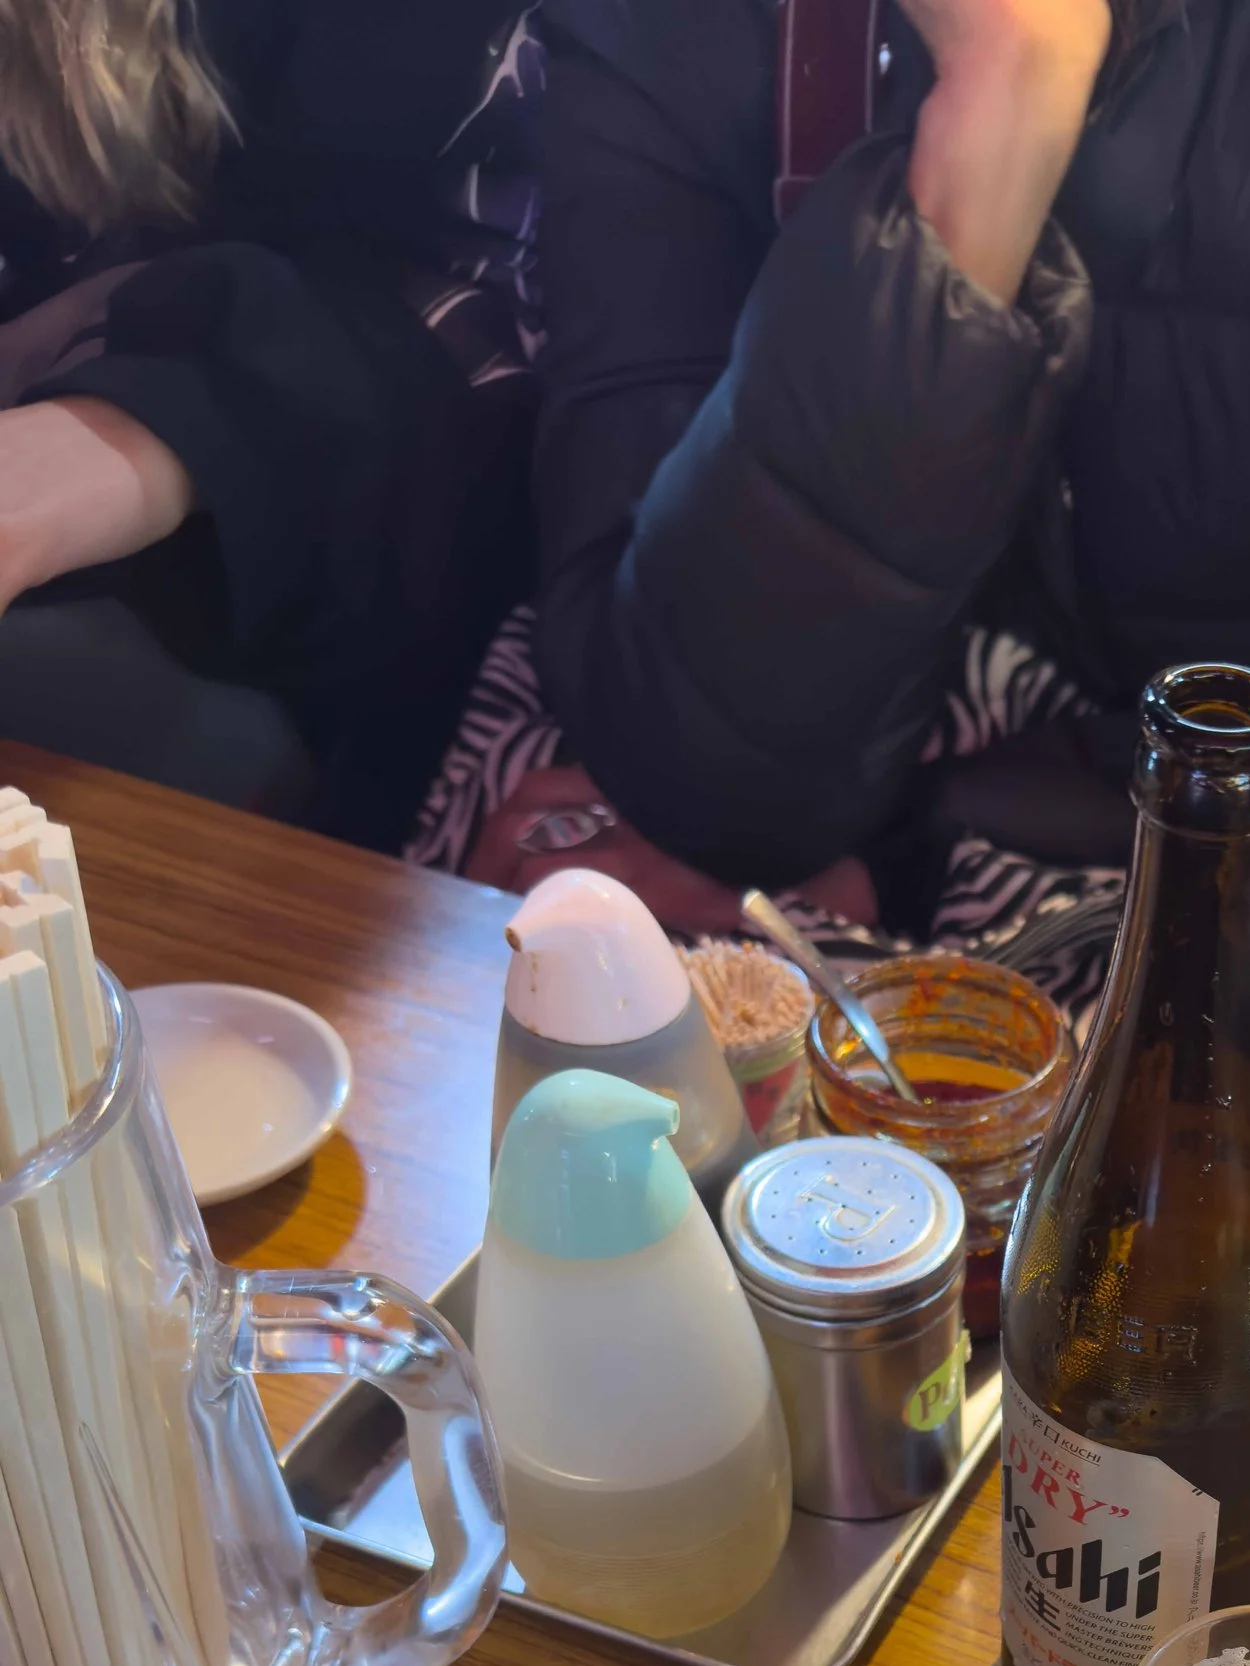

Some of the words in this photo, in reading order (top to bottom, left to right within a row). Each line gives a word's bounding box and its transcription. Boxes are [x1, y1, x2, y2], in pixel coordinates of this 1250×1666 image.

[1020, 1428, 1081, 1486] SUPER
[1061, 1439, 1102, 1463] KUCHI
[1025, 1580, 1061, 1632] 生
[1067, 1601, 1113, 1624] PRECISION
[1115, 1620, 1129, 1628] TO
[1130, 1623, 1156, 1632] HIGH
[1065, 1611, 1097, 1628] UNDER
[1100, 1624, 1117, 1635] THE
[1065, 1621, 1103, 1640] MASTER
[1065, 1631, 1082, 1643] ING
[1086, 1651, 1118, 1666] CLEAN
